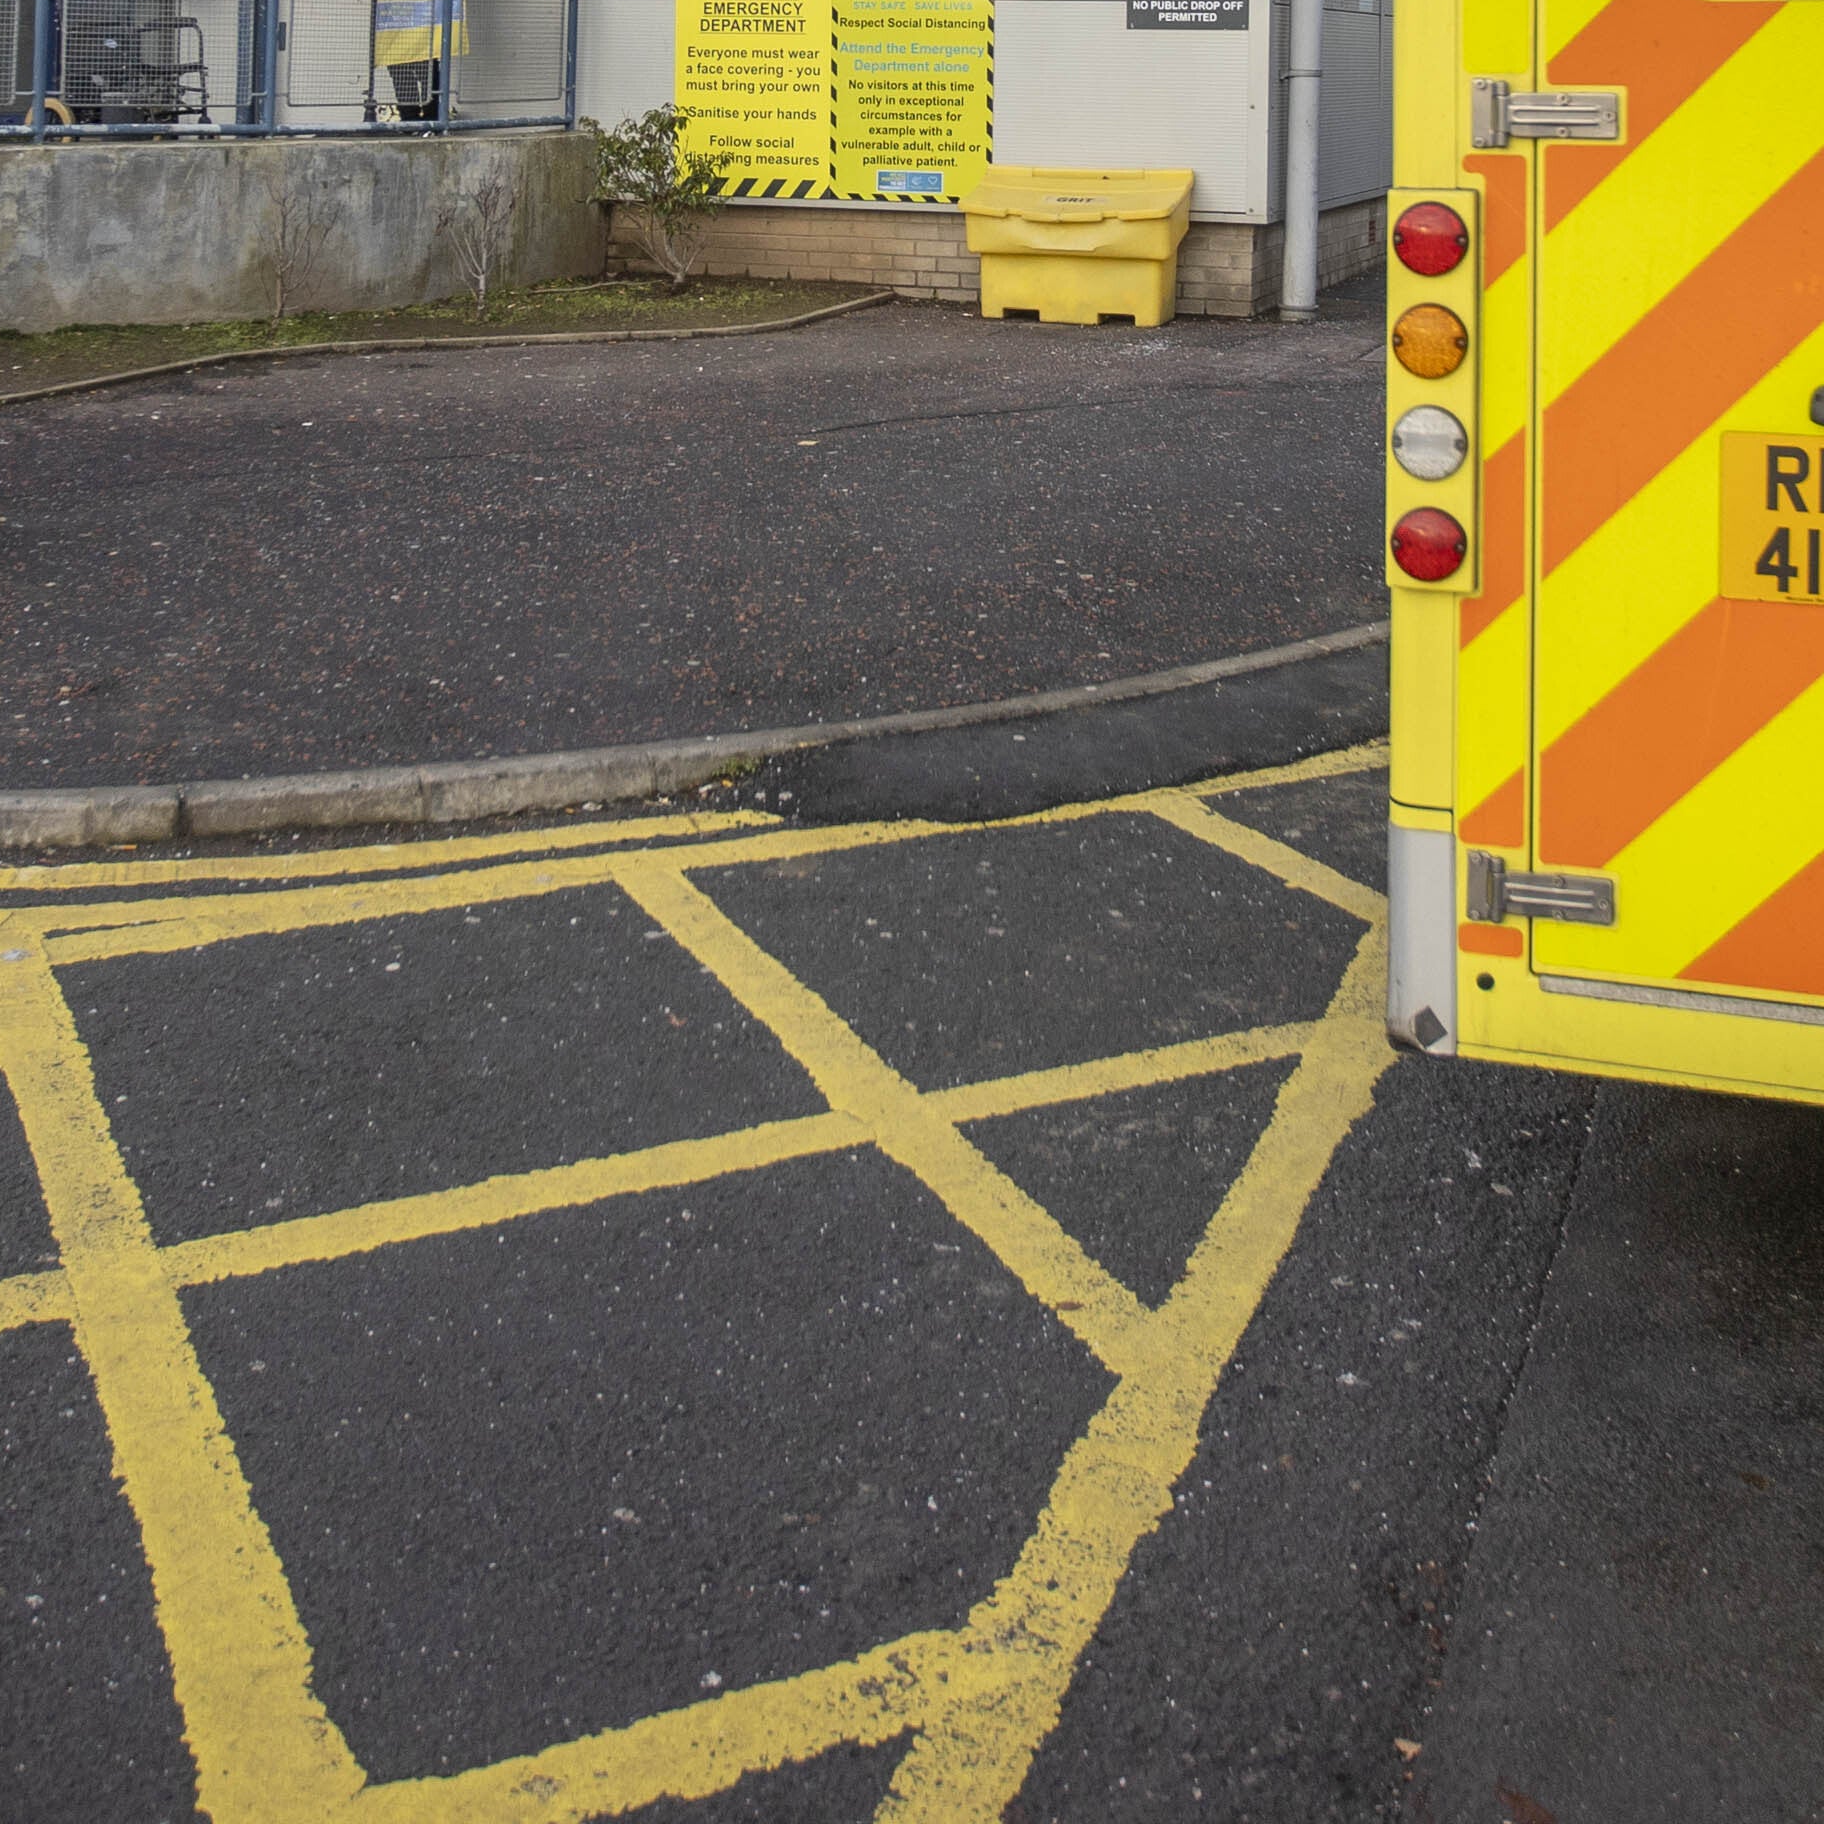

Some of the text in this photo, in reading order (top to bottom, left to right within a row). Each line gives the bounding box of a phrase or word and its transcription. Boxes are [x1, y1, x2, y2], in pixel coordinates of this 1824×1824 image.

[703, 2, 803, 15] EMERGENCY
[853, 1, 973, 10] STAY SAFE SAVE LIVES
[1133, 1, 1243, 11] NO PUBLIC DROP OFF
[1158, 13, 1218, 22] PERMITTED
[700, 19, 806, 32] DEPARTMENT
[839, 18, 986, 31] Respect Social Distancing
[687, 47, 820, 60] Everyone must wear
[840, 42, 984, 57] Attend the Emergency
[686, 65, 693, 74] a
[697, 63, 723, 74] face
[727, 64, 784, 78] covering
[796, 67, 821, 79] you
[854, 60, 969, 72] Department alone
[686, 80, 820, 94] must bring your own
[848, 80, 975, 92] No visitors at this time
[858, 95, 964, 108] only in exceptional
[688, 106, 817, 121] Sanitise your hands
[860, 111, 962, 121] circumstances for
[868, 126, 916, 137] example
[919, 126, 943, 136] with
[709, 135, 795, 148] Follow social
[841, 140, 899, 151] vulnerable
[903, 141, 934, 152] adult,
[938, 142, 965, 152] child
[756, 155, 819, 166] measures
[862, 155, 958, 168] palliative patient.
